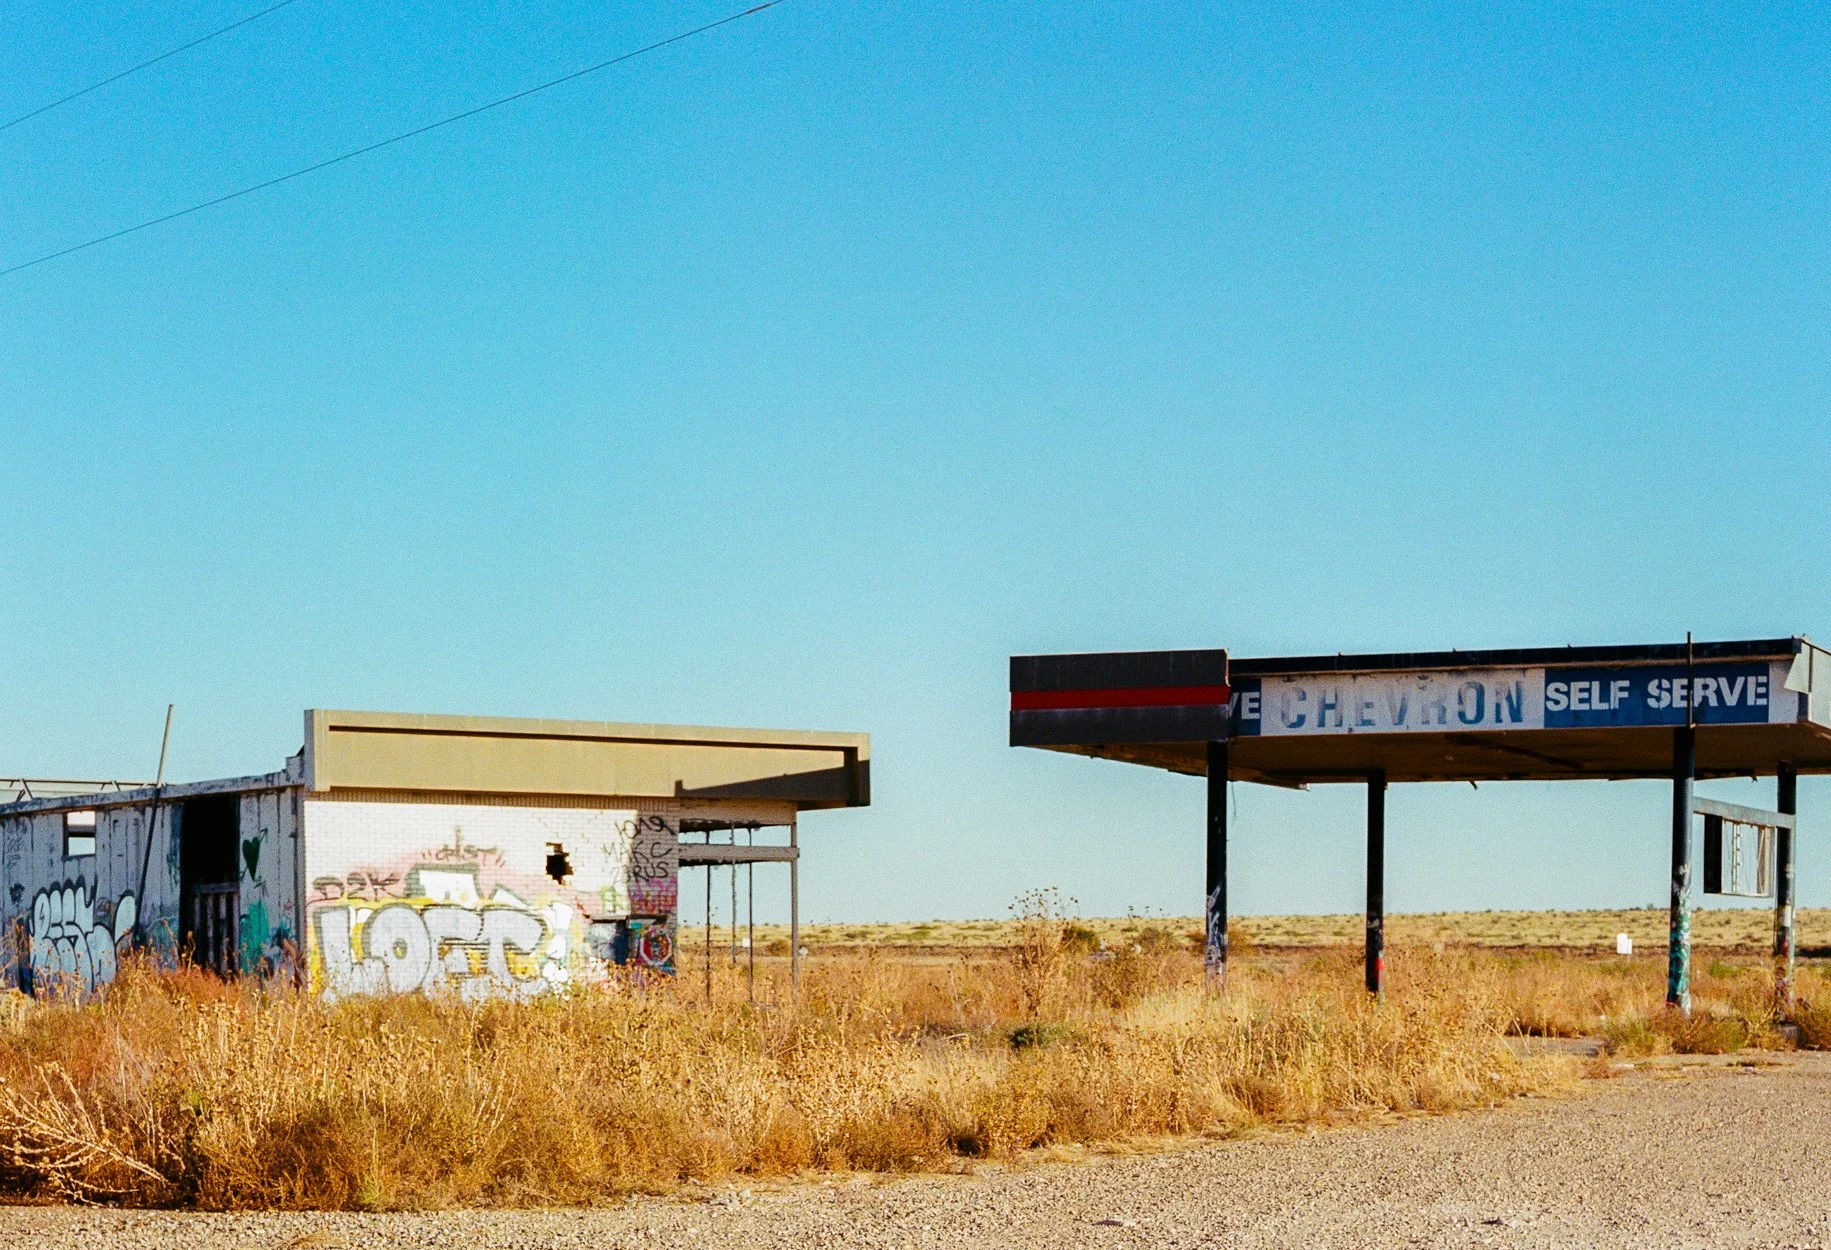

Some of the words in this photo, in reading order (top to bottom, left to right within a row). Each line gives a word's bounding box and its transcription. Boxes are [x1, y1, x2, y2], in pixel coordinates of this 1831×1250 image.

[1280, 680, 1525, 729] CHEVRON
[1545, 679, 1631, 712] SELF
[1646, 674, 1769, 710] SERVE
